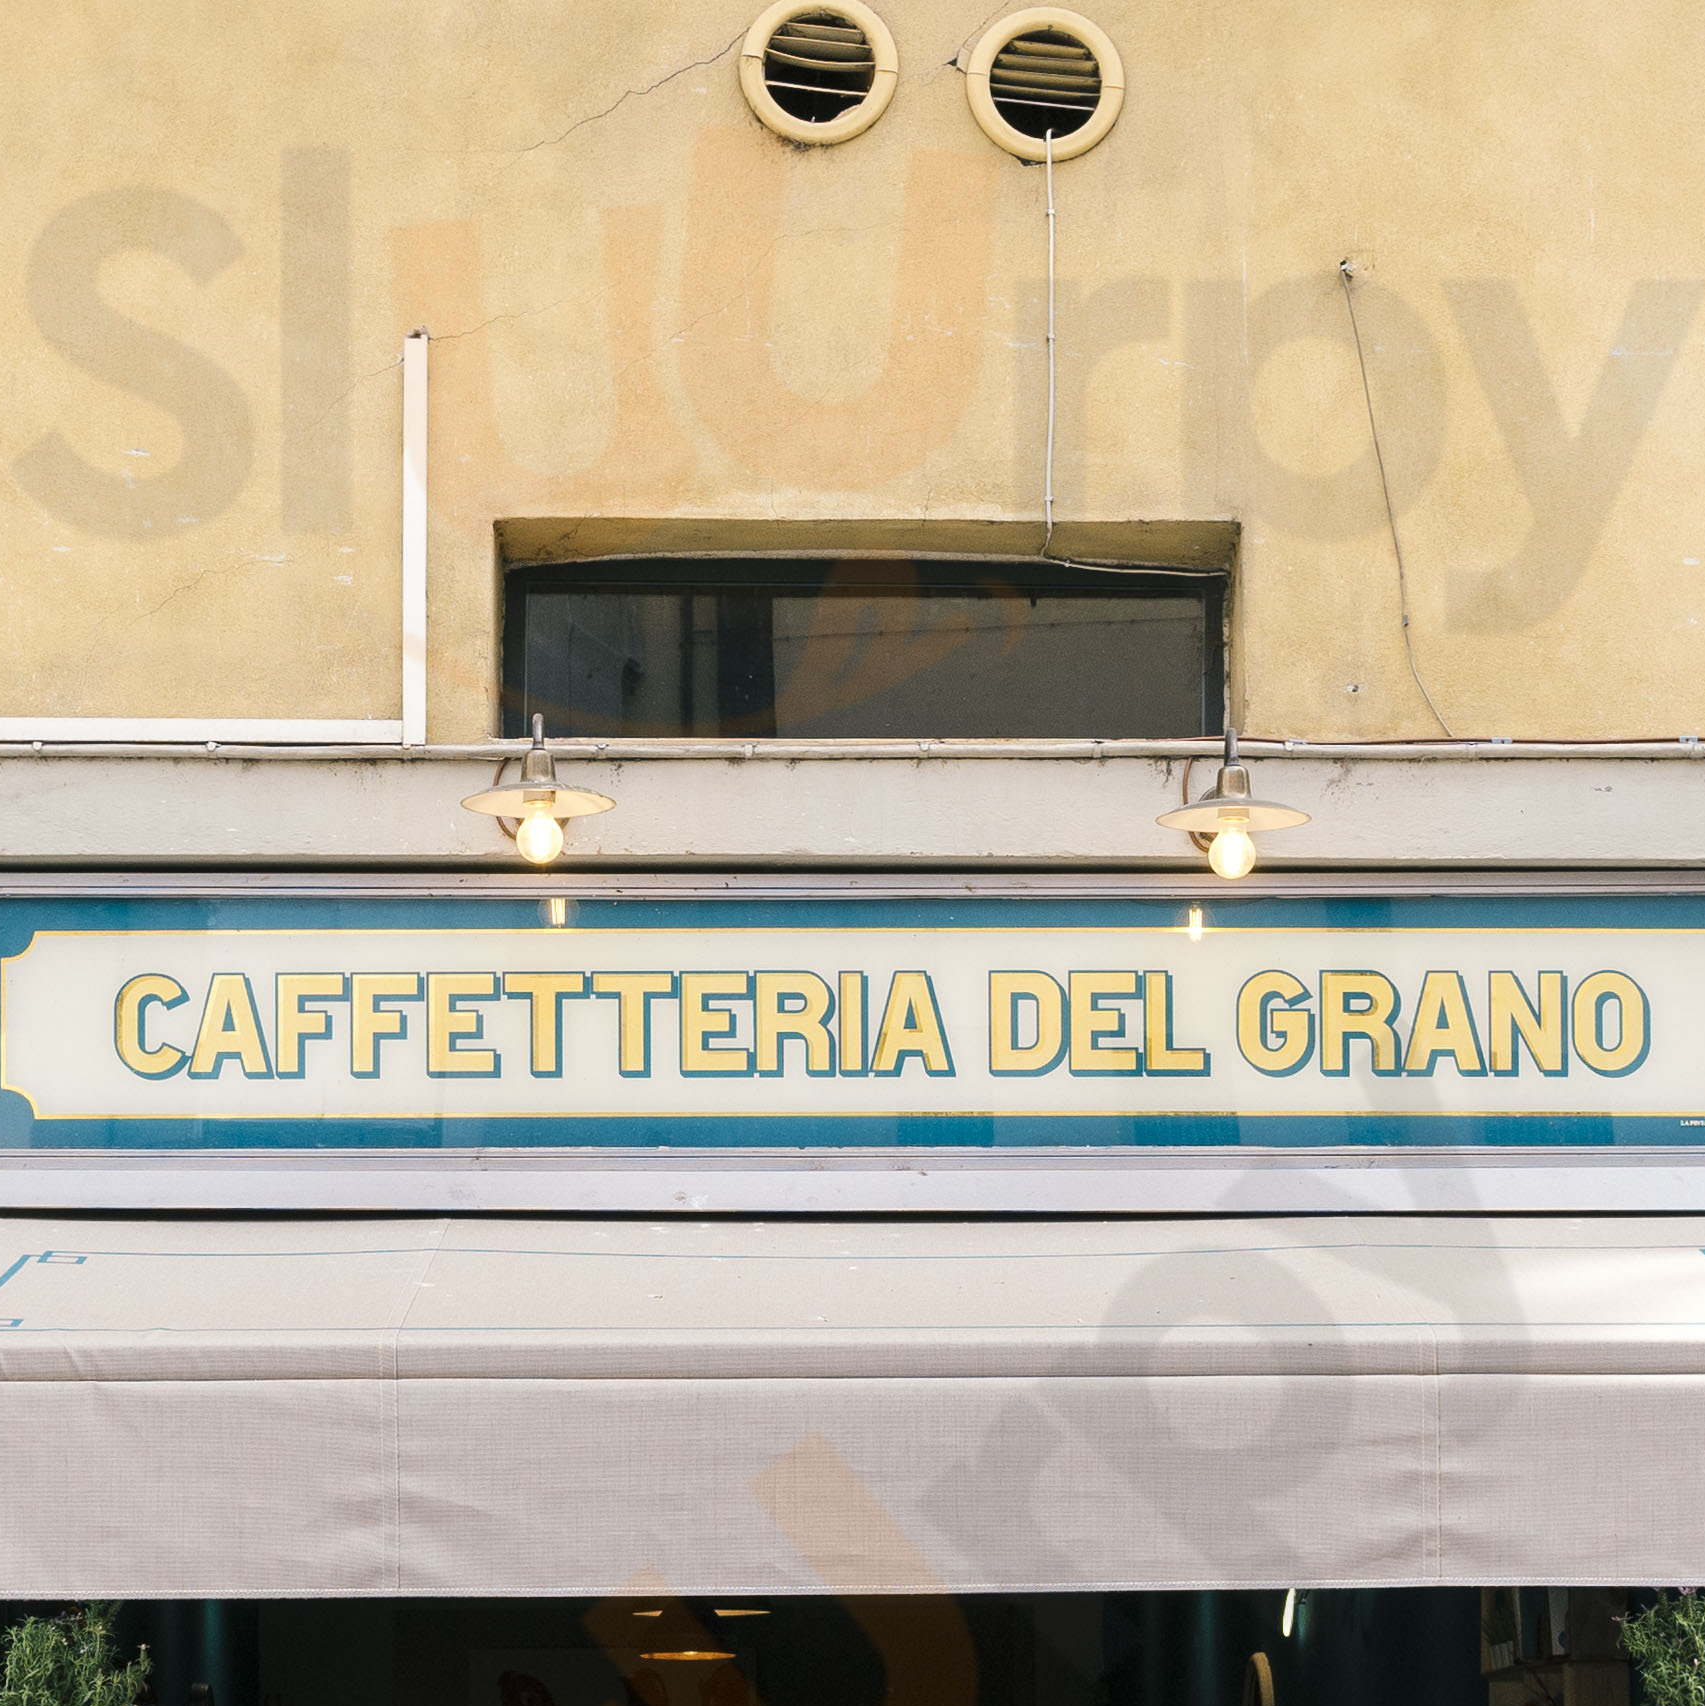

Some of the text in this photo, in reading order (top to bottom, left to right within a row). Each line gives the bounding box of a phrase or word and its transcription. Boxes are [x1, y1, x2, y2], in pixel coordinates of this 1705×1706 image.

[113, 968, 1652, 1080] CAFFETTERIA DEL GRANO
